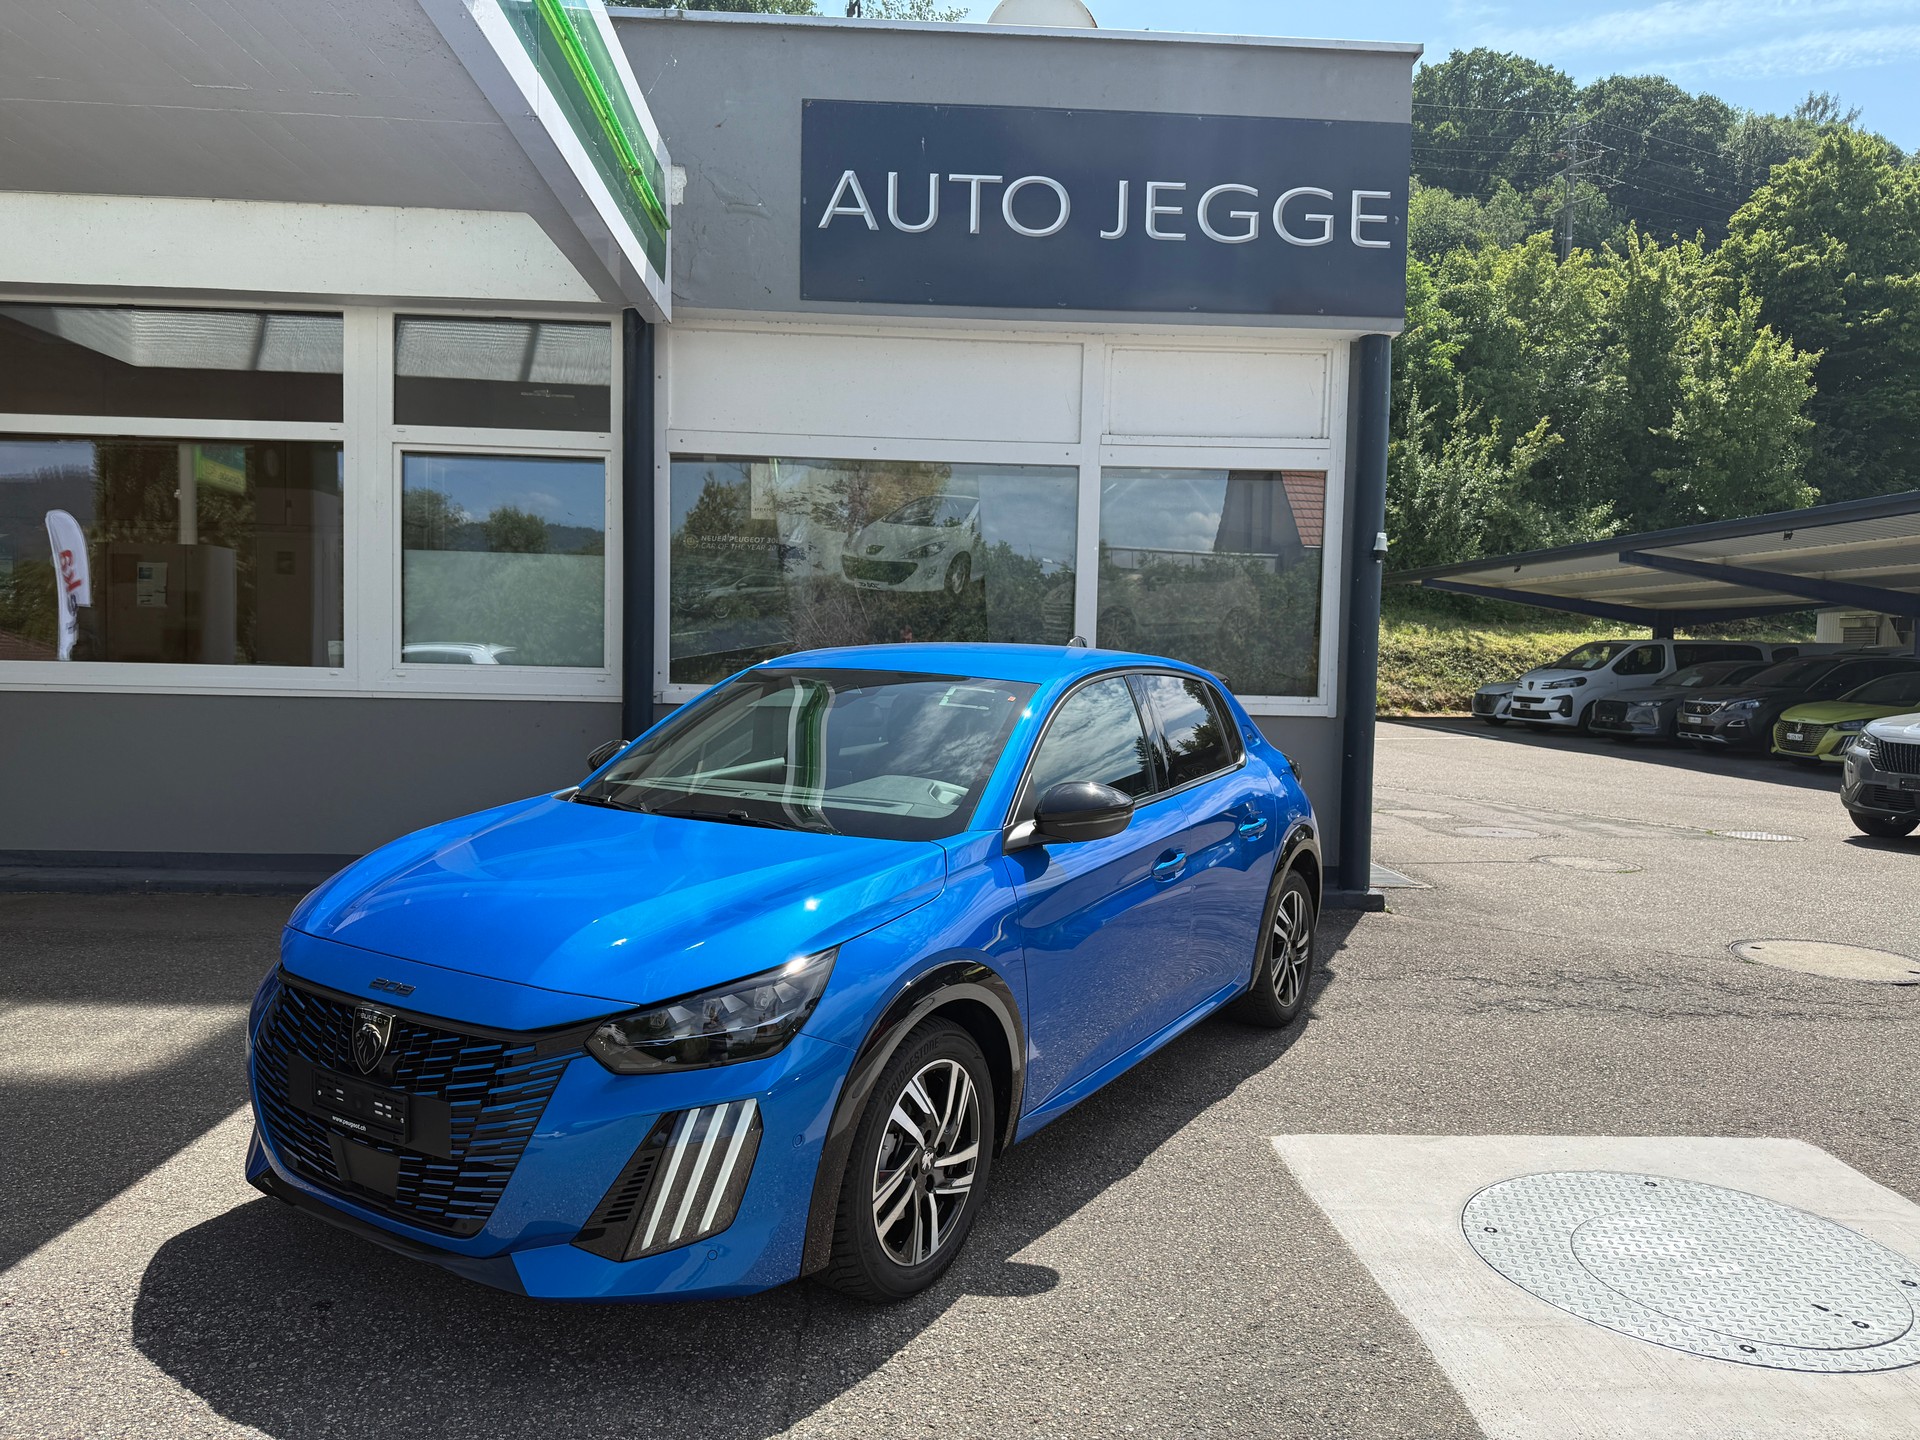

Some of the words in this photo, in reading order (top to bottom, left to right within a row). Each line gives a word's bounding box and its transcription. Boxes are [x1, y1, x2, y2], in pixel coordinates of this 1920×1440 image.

[818, 170, 1071, 238] AUTO
[1100, 180, 1392, 249] JEGGE
[729, 535, 765, 544] PEUGEOT
[368, 977, 417, 998] 208
[883, 1036, 941, 1105] BRIDGESTONE
